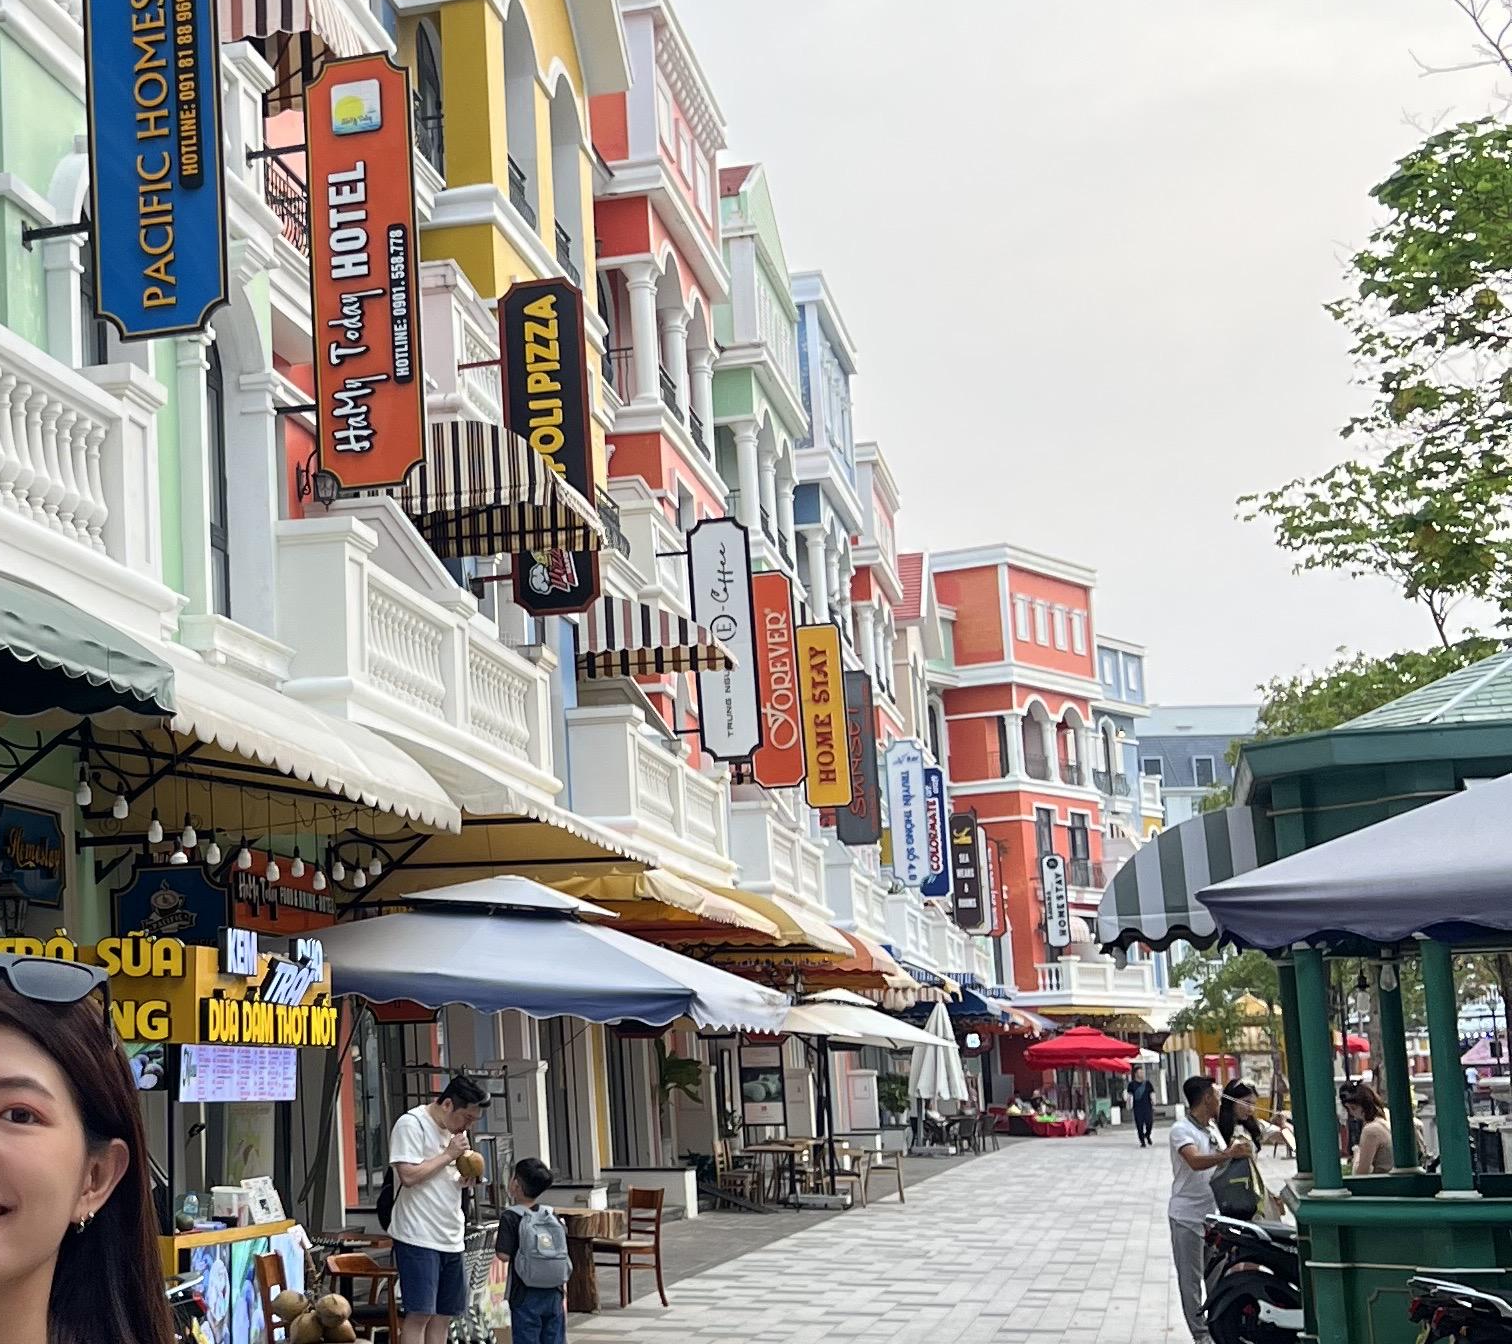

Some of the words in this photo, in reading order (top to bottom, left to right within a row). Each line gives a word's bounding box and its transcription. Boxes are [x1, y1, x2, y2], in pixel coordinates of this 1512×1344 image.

[176, 24, 193, 45] 88
[177, 50, 194, 68] 81
[178, 72, 196, 101] 091
[180, 103, 199, 176] HOTLINE:
[138, 152, 177, 310] PACIFIC
[327, 160, 369, 280] HOTEL
[393, 319, 410, 377] HOTLINE:
[523, 294, 561, 394] PIZZA
[808, 645, 831, 706] STAY
[726, 698, 735, 738] TRUNG
[813, 712, 838, 785] HOME
[96, 931, 183, 978] SỮA
[226, 927, 258, 976] KEM
